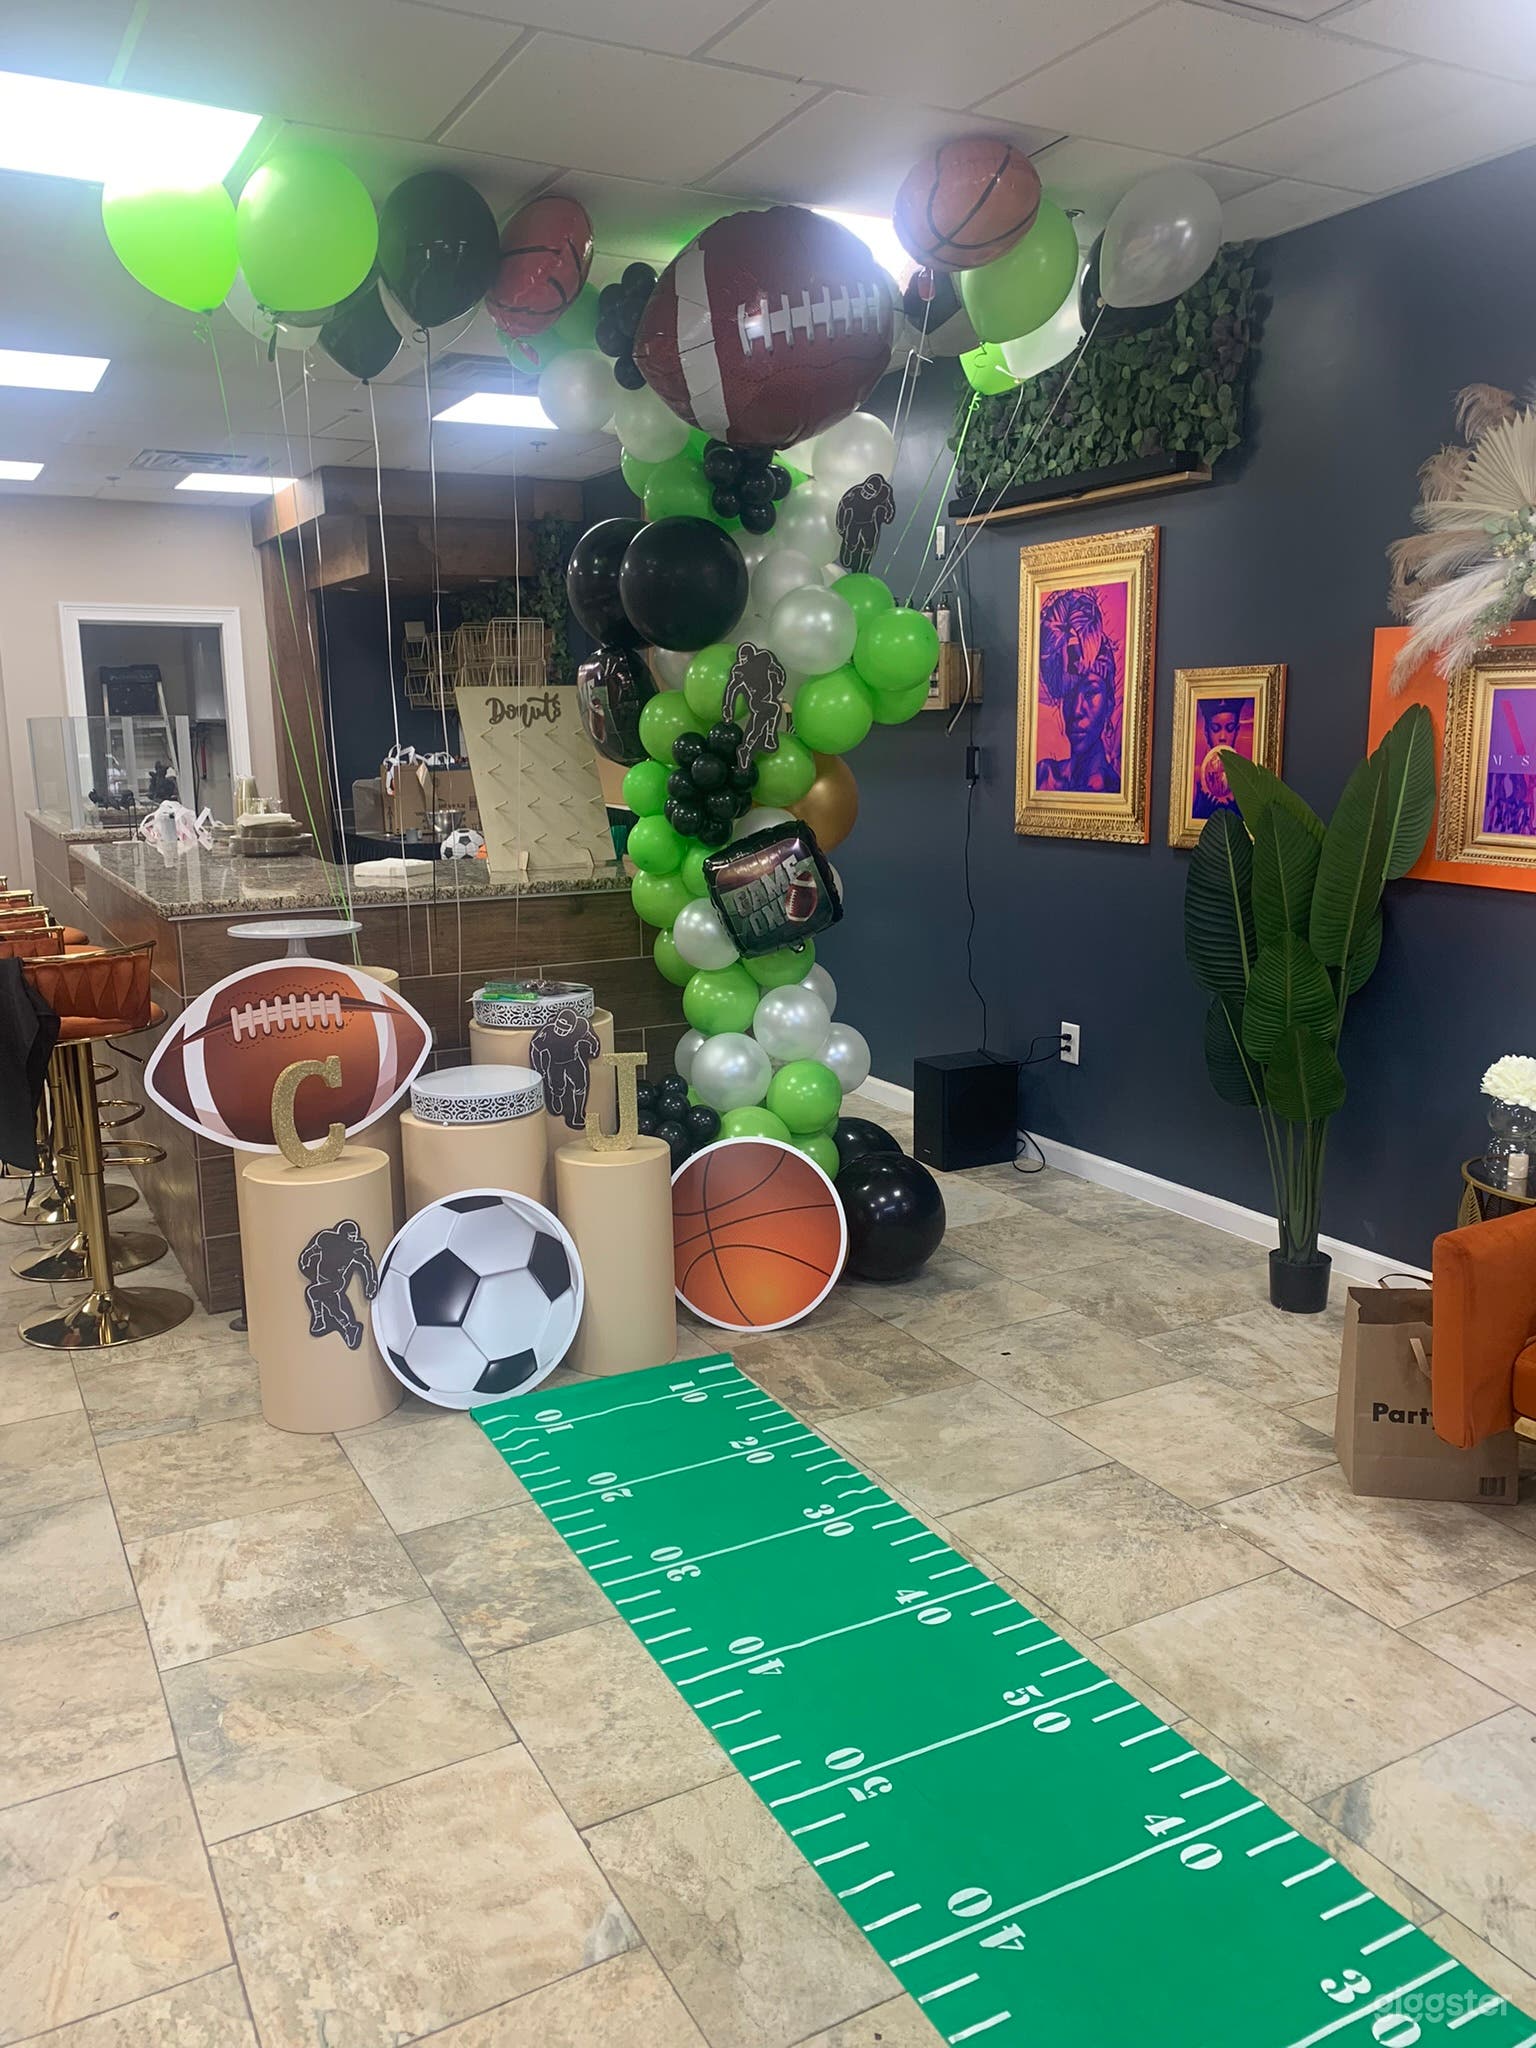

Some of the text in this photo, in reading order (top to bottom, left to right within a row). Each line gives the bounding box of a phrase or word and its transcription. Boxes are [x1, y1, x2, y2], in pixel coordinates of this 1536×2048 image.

[486, 692, 562, 728] Donuts
[733, 854, 799, 918] GAME
[271, 1055, 346, 1169] C
[585, 1052, 648, 1152] J
[669, 1380, 708, 1403] 10
[535, 1409, 574, 1434] 10
[1372, 1402, 1434, 1430] Part
[729, 1436, 775, 1464] 20
[587, 1472, 633, 1503] 20
[803, 1504, 854, 1537] 30
[650, 1546, 701, 1582] 30
[895, 1589, 952, 1625] 40
[728, 1636, 785, 1675] 40
[1003, 1685, 1071, 1733] 50
[825, 1747, 893, 1802] 50
[1145, 1815, 1222, 1870] 40
[947, 1887, 1026, 1951] 40
[1320, 1969, 1421, 2048] 30
